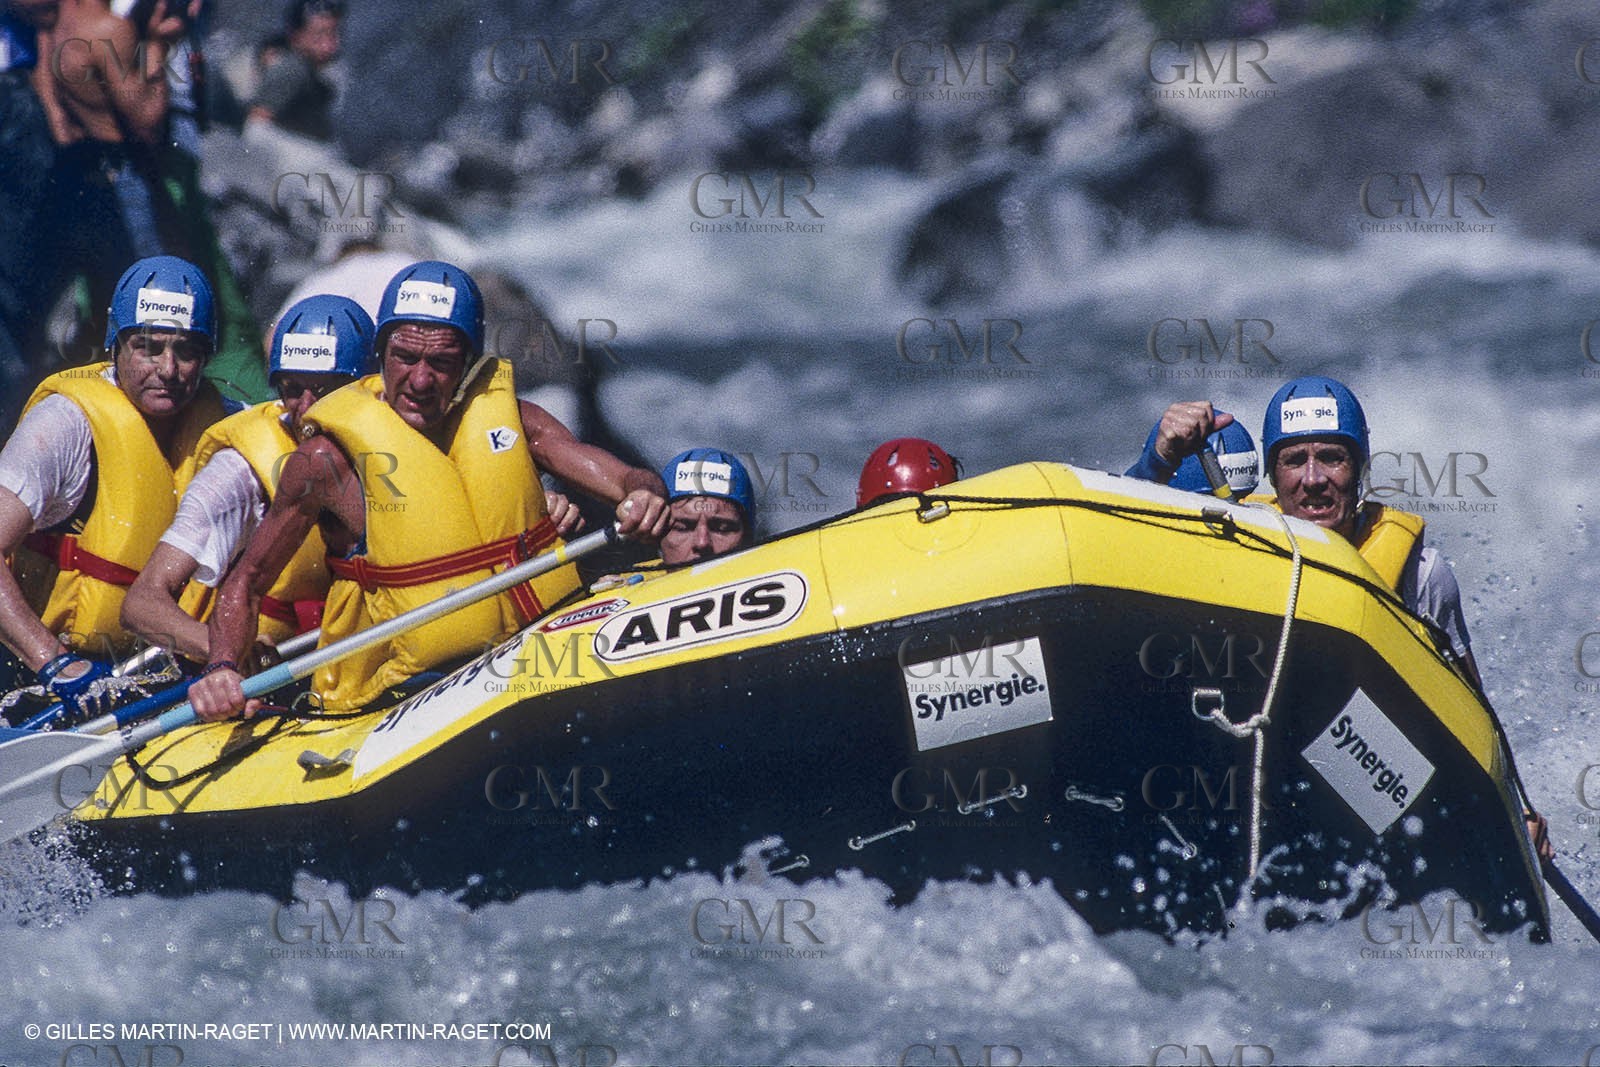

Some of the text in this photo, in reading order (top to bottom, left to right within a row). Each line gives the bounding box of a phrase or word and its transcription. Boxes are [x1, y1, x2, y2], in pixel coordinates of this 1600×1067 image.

[400, 290, 450, 305] Syngie.
[139, 299, 190, 315] Synergie.
[283, 344, 332, 358] Synergie.
[1283, 407, 1335, 421] Syngie.
[612, 581, 786, 653] ARIS
[915, 673, 1045, 721] Synergie.
[1330, 714, 1409, 809] Synergie.
